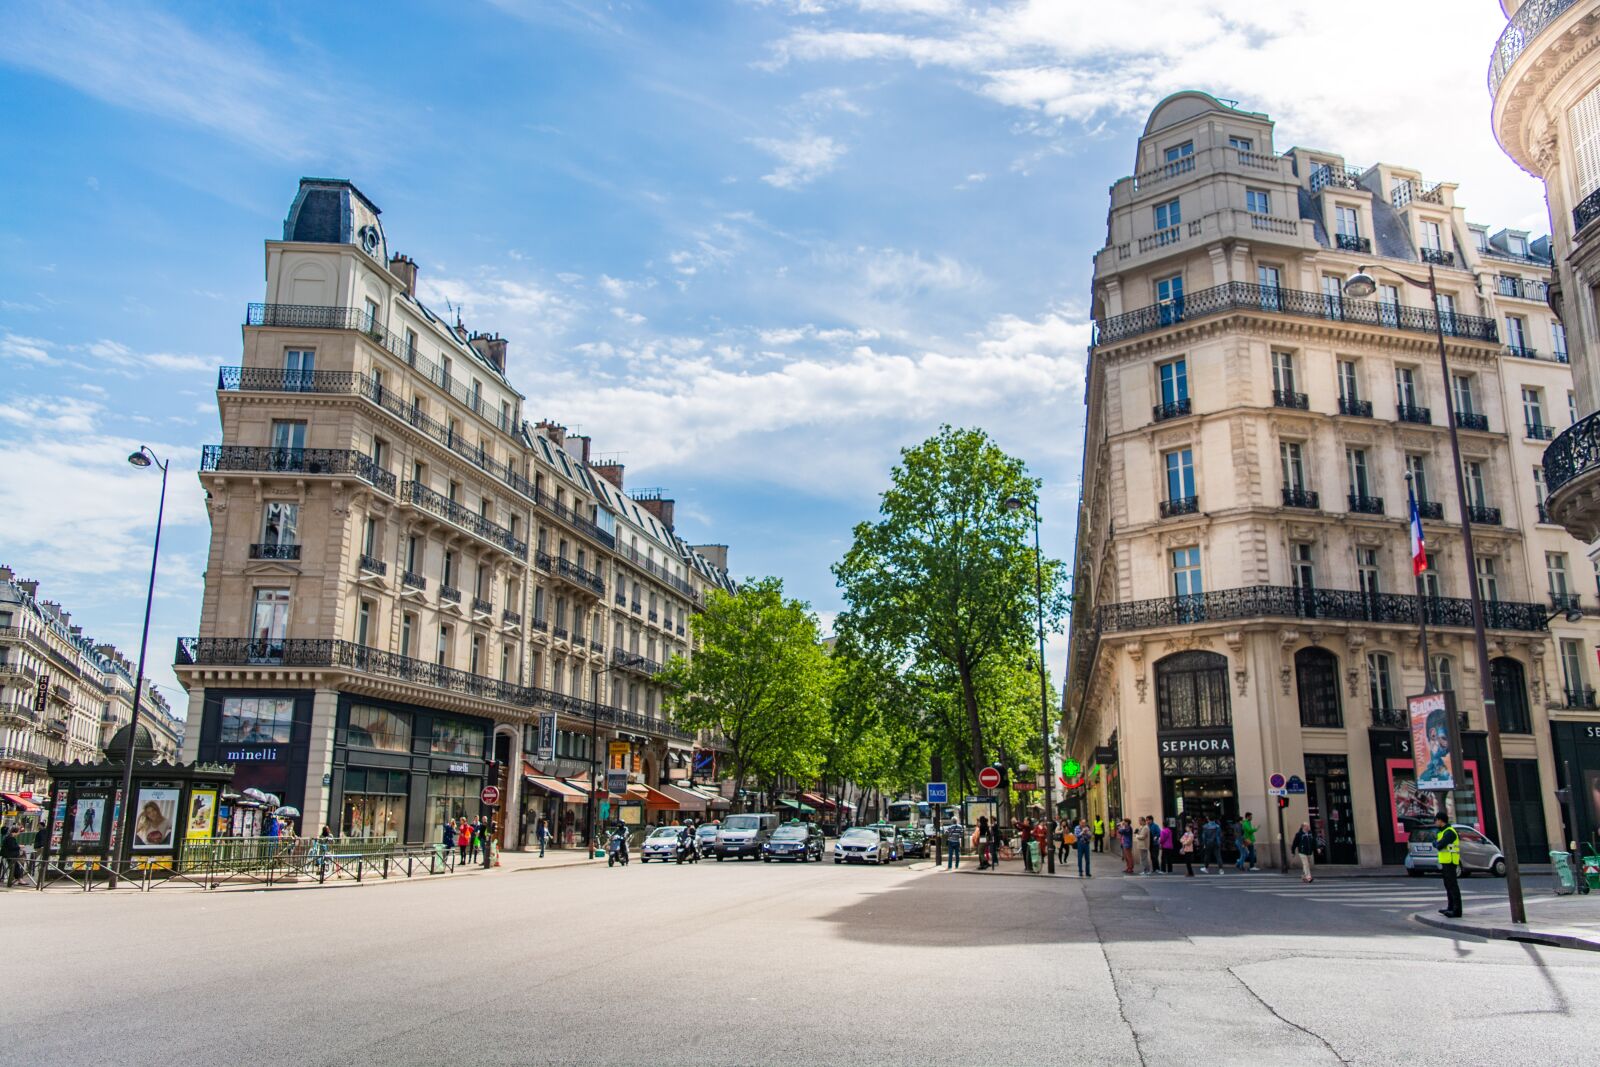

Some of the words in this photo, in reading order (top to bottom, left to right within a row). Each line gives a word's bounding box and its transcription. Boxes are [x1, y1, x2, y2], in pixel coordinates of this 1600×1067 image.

[37, 676, 47, 711] HOTEL
[1162, 739, 1230, 752] SEPHORA
[226, 748, 277, 760] minelli
[929, 789, 946, 797] TAXIS
